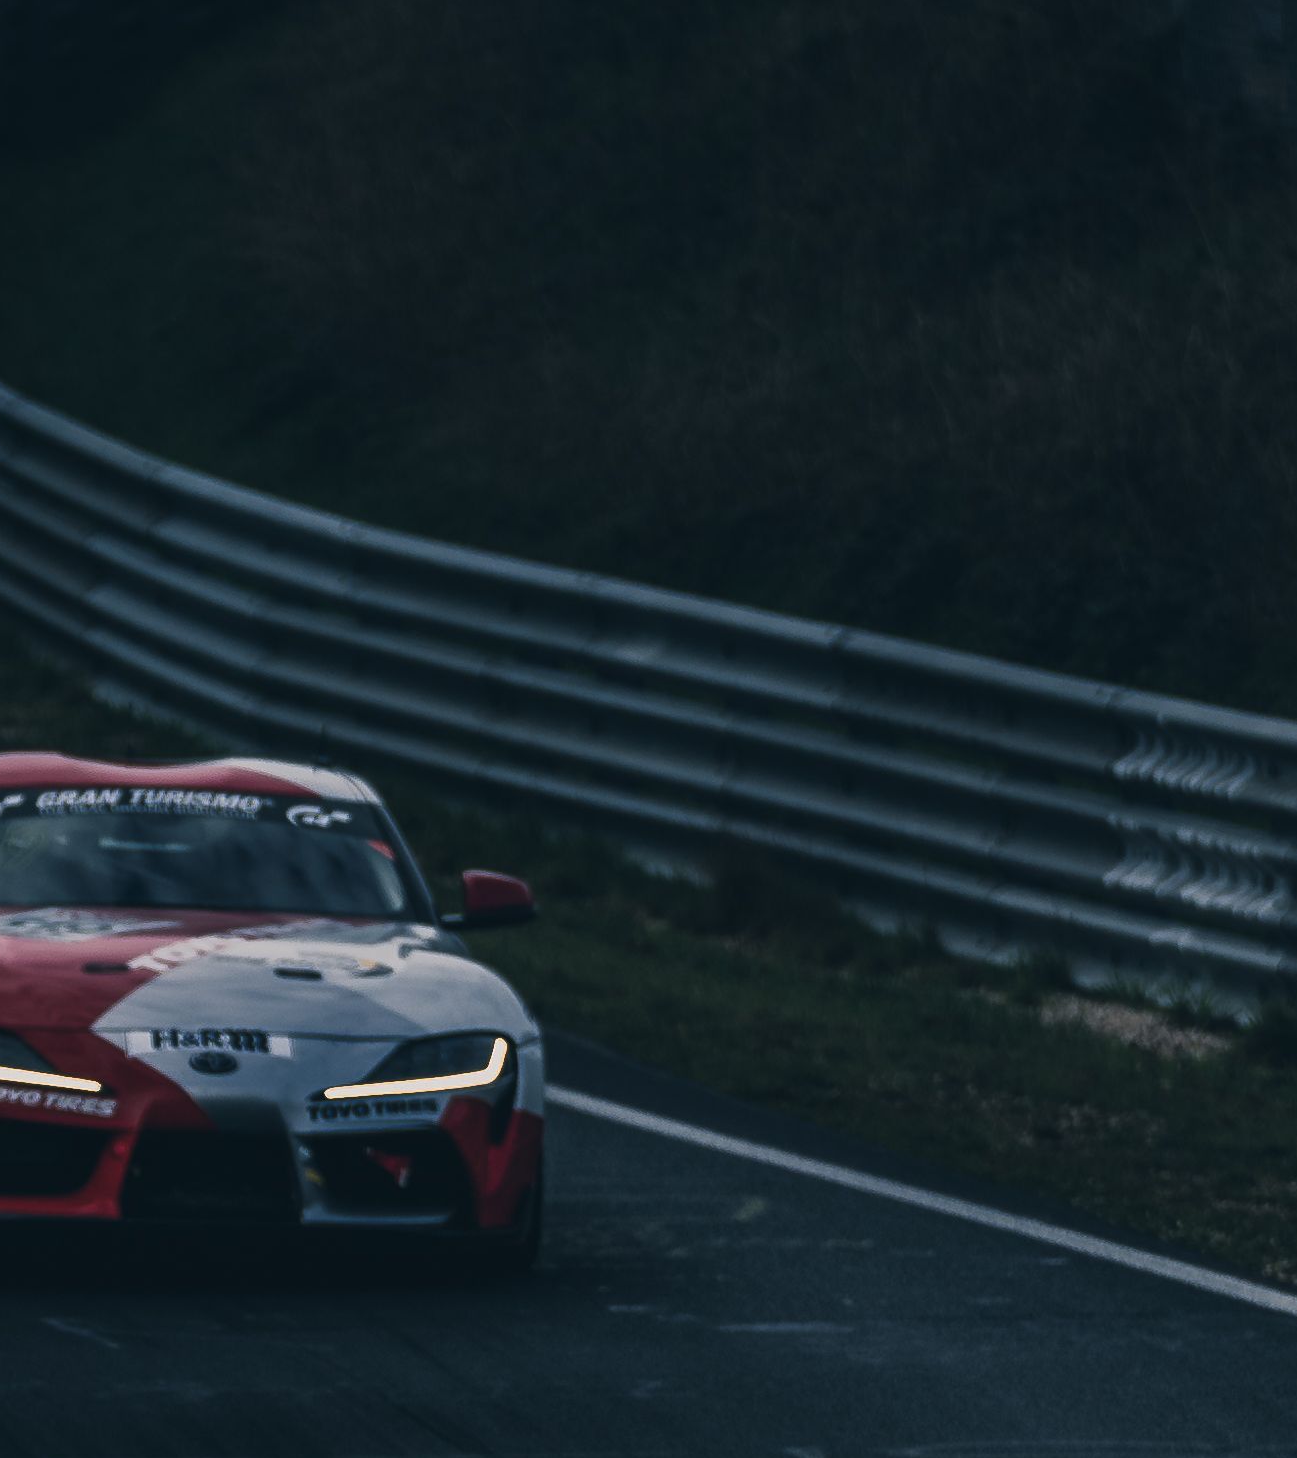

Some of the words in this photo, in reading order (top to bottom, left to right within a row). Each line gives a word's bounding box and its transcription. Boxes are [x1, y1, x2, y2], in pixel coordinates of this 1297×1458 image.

[35, 790, 124, 807] GRAN
[127, 788, 263, 812] TURISMO
[306, 1101, 370, 1122] TOYO
